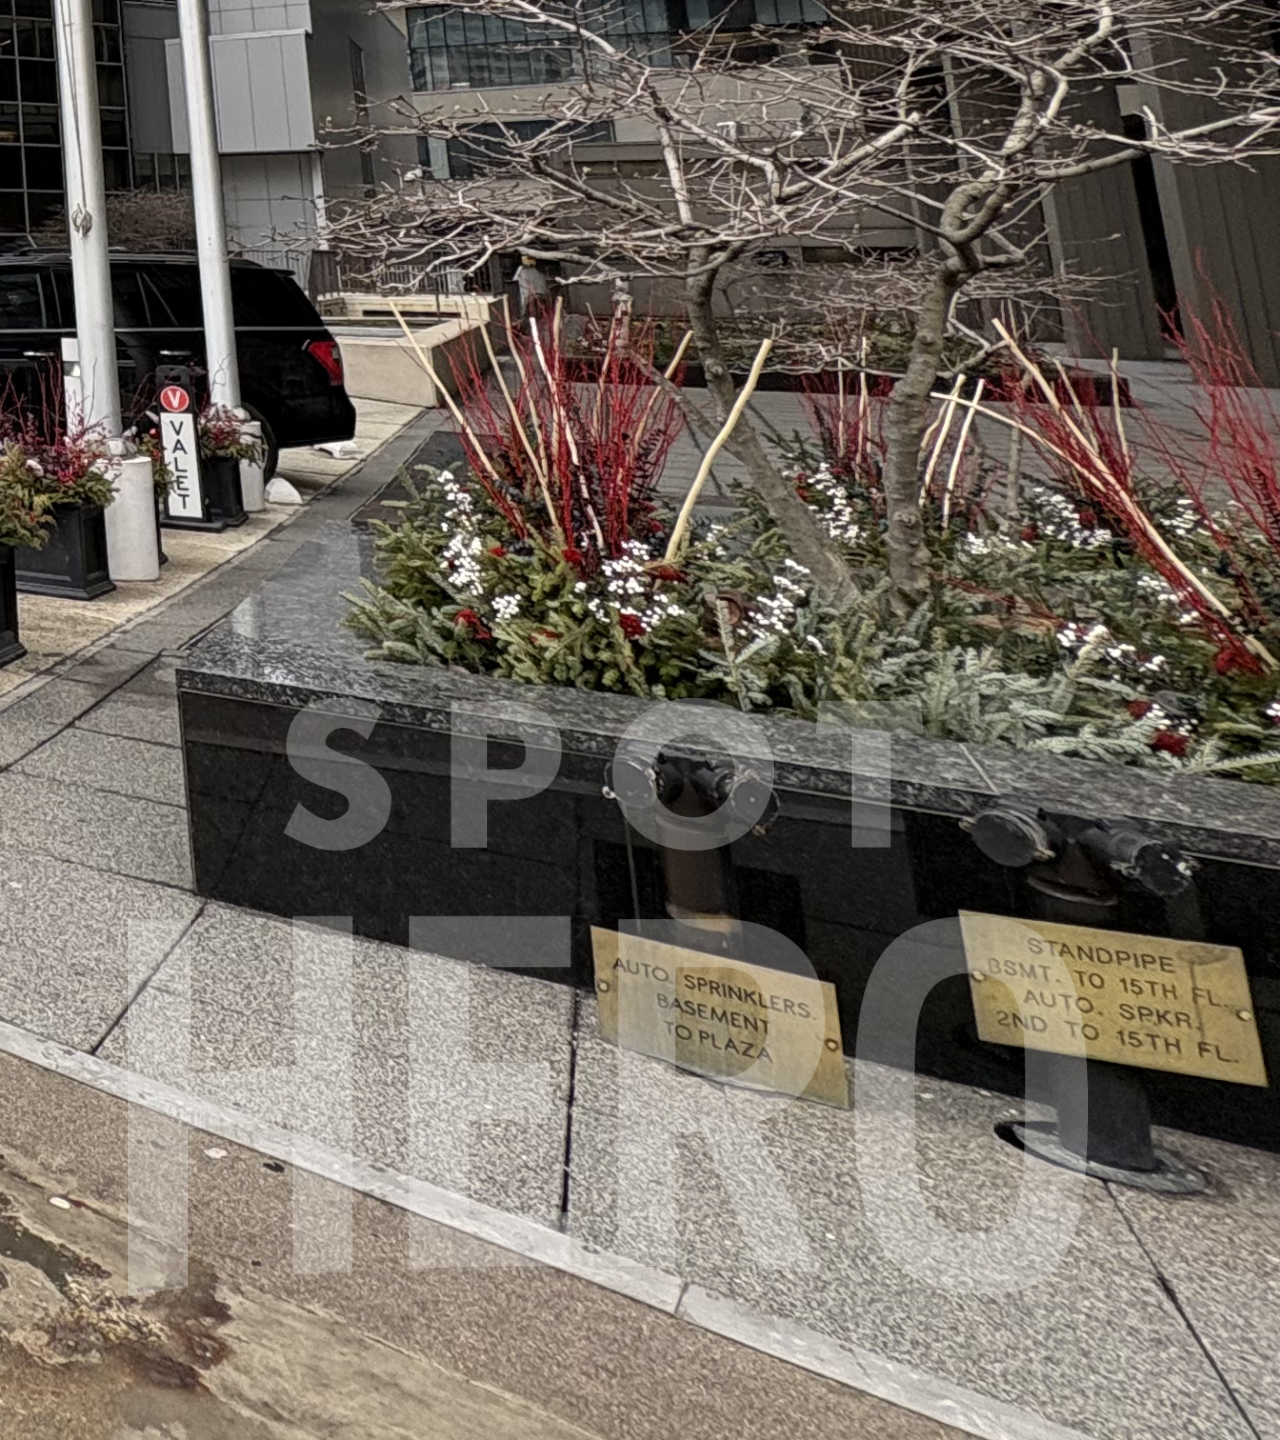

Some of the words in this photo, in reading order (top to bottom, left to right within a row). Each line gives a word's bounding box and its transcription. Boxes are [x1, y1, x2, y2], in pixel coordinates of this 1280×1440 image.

[167, 390, 181, 409] V
[169, 420, 190, 509] VALET
[1027, 938, 1176, 974] STANDPIPE
[987, 958, 1061, 984] BSMT.
[1075, 970, 1105, 989] TO
[1120, 977, 1178, 1001] 15TH
[1192, 987, 1229, 1008] FL.
[1024, 989, 1104, 1015] AUTO.
[657, 993, 769, 1035] BASEMENT
[664, 1020, 692, 1040] TO
[698, 1030, 773, 1064] PLAZA
[997, 1010, 1048, 1033] 2ND
[1065, 1020, 1100, 1041] TO
[1117, 1029, 1181, 1055] 15TH
[1198, 1040, 1240, 1063] FL.
